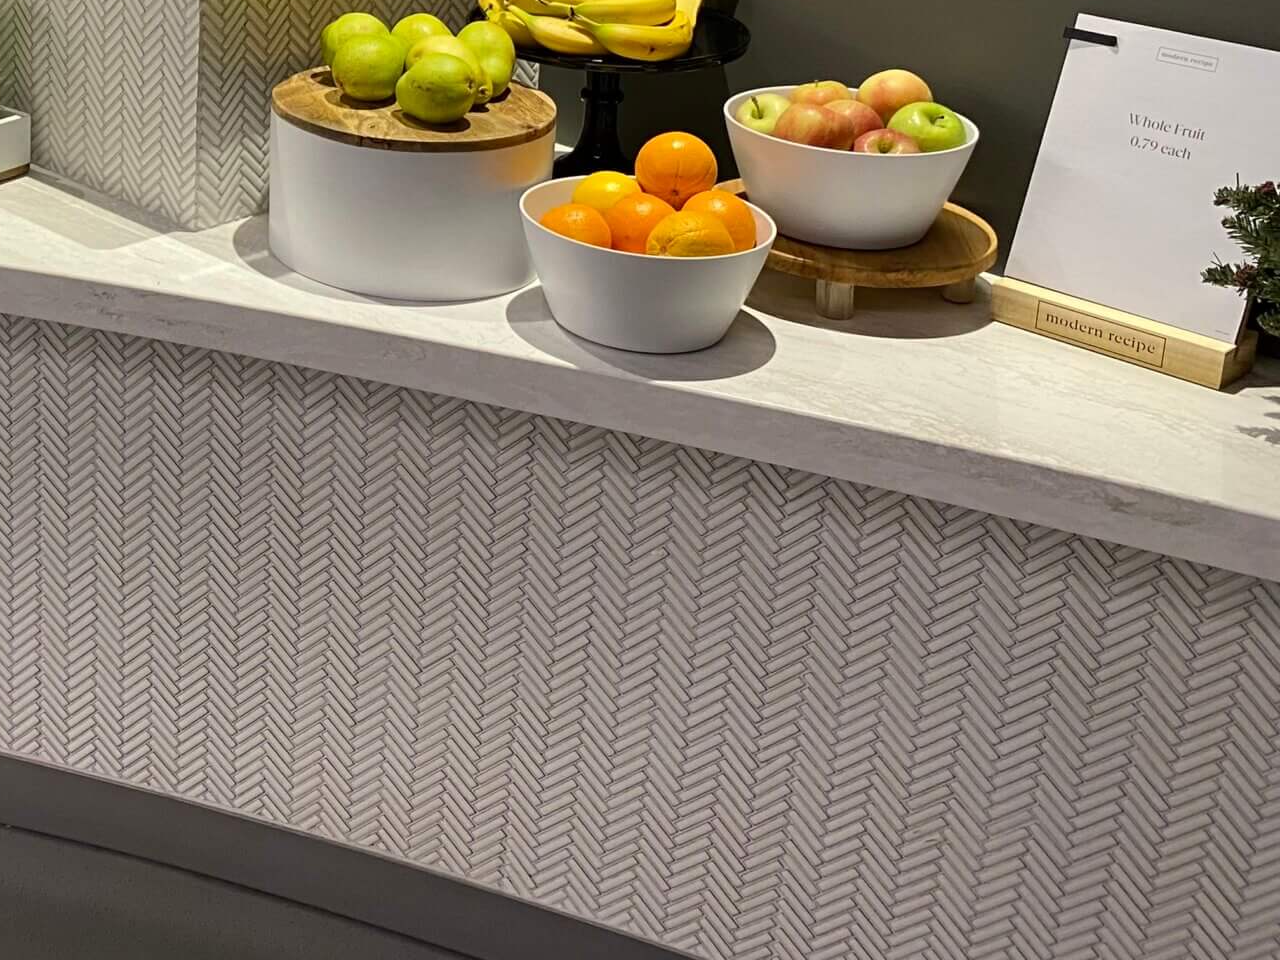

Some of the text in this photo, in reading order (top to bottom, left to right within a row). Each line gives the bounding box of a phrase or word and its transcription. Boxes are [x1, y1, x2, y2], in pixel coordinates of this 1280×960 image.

[1130, 112, 1205, 141] Whole Fruit
[1130, 135, 1191, 160] 0.79 each
[1046, 313, 1156, 353] modern recipe
